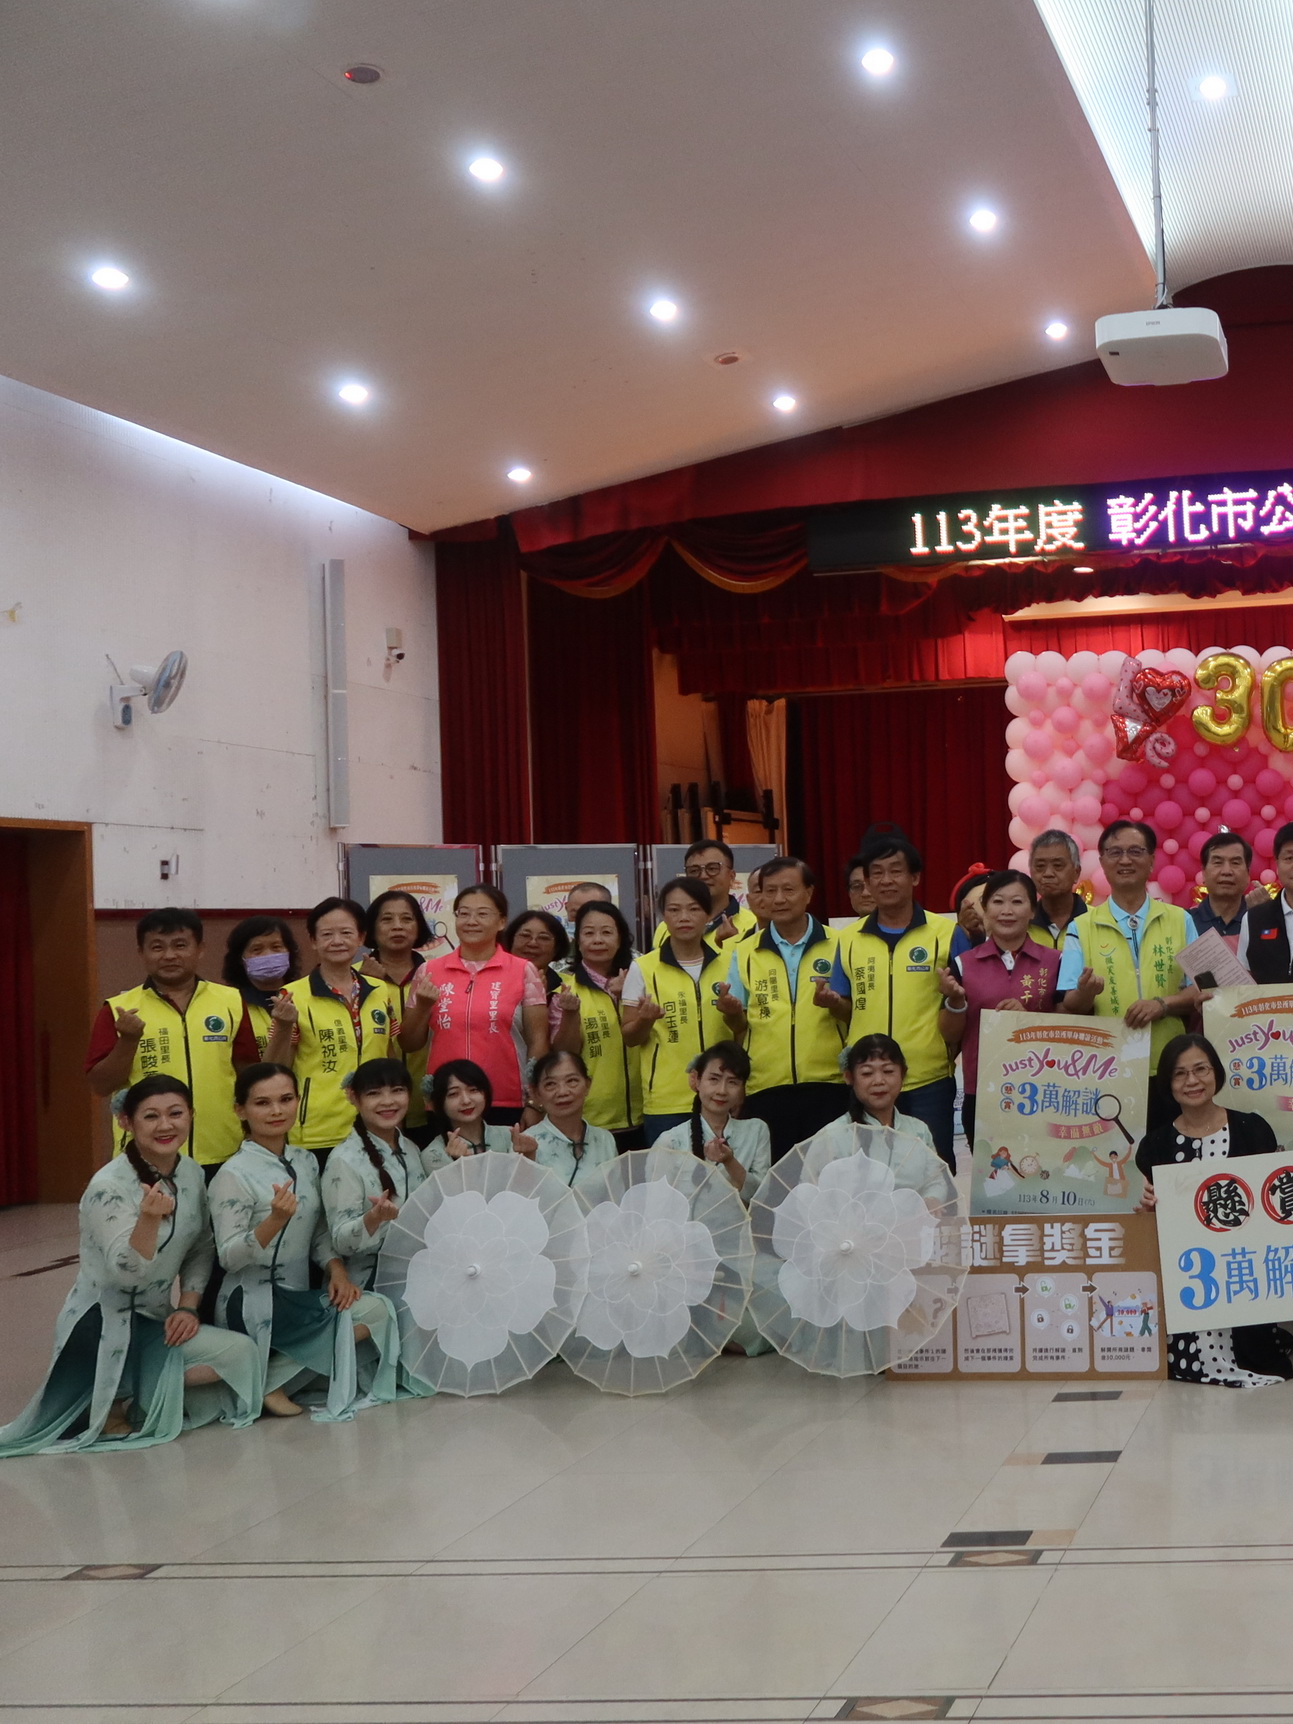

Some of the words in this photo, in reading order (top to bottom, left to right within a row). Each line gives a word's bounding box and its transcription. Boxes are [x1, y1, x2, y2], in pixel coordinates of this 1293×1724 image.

[909, 500, 1085, 555] 113年度
[1153, 944, 1167, 988] 林世賢
[1165, 936, 1174, 974] 彰化市長
[437, 982, 455, 1030] 陳堂怡
[854, 966, 866, 1011] 蔡國煌
[158, 1028, 171, 1064] 福田里長
[318, 1028, 338, 1074] 陳祝汝
[1058, 1121, 1104, 1139] 幸福無敵
